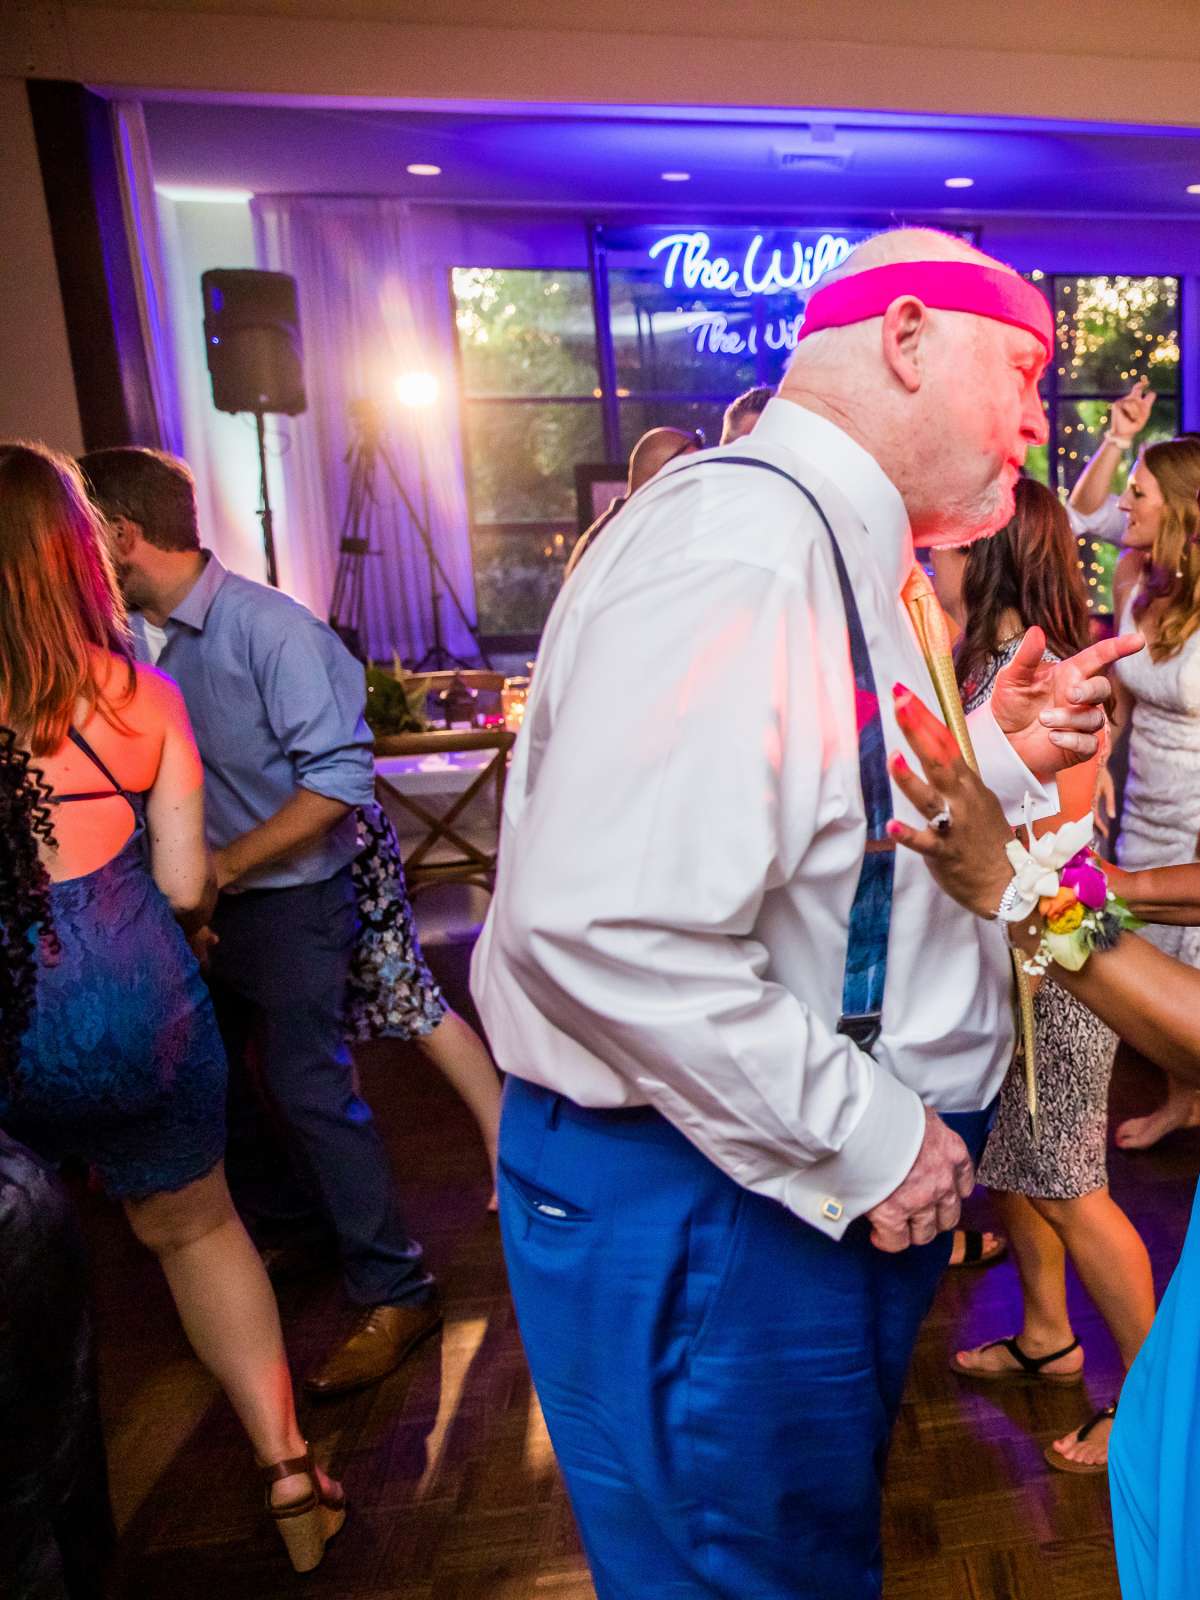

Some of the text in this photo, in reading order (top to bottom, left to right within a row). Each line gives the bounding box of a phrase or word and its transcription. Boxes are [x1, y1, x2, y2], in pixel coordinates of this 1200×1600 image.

[649, 232, 857, 293] The Will
[688, 315, 746, 354] The
